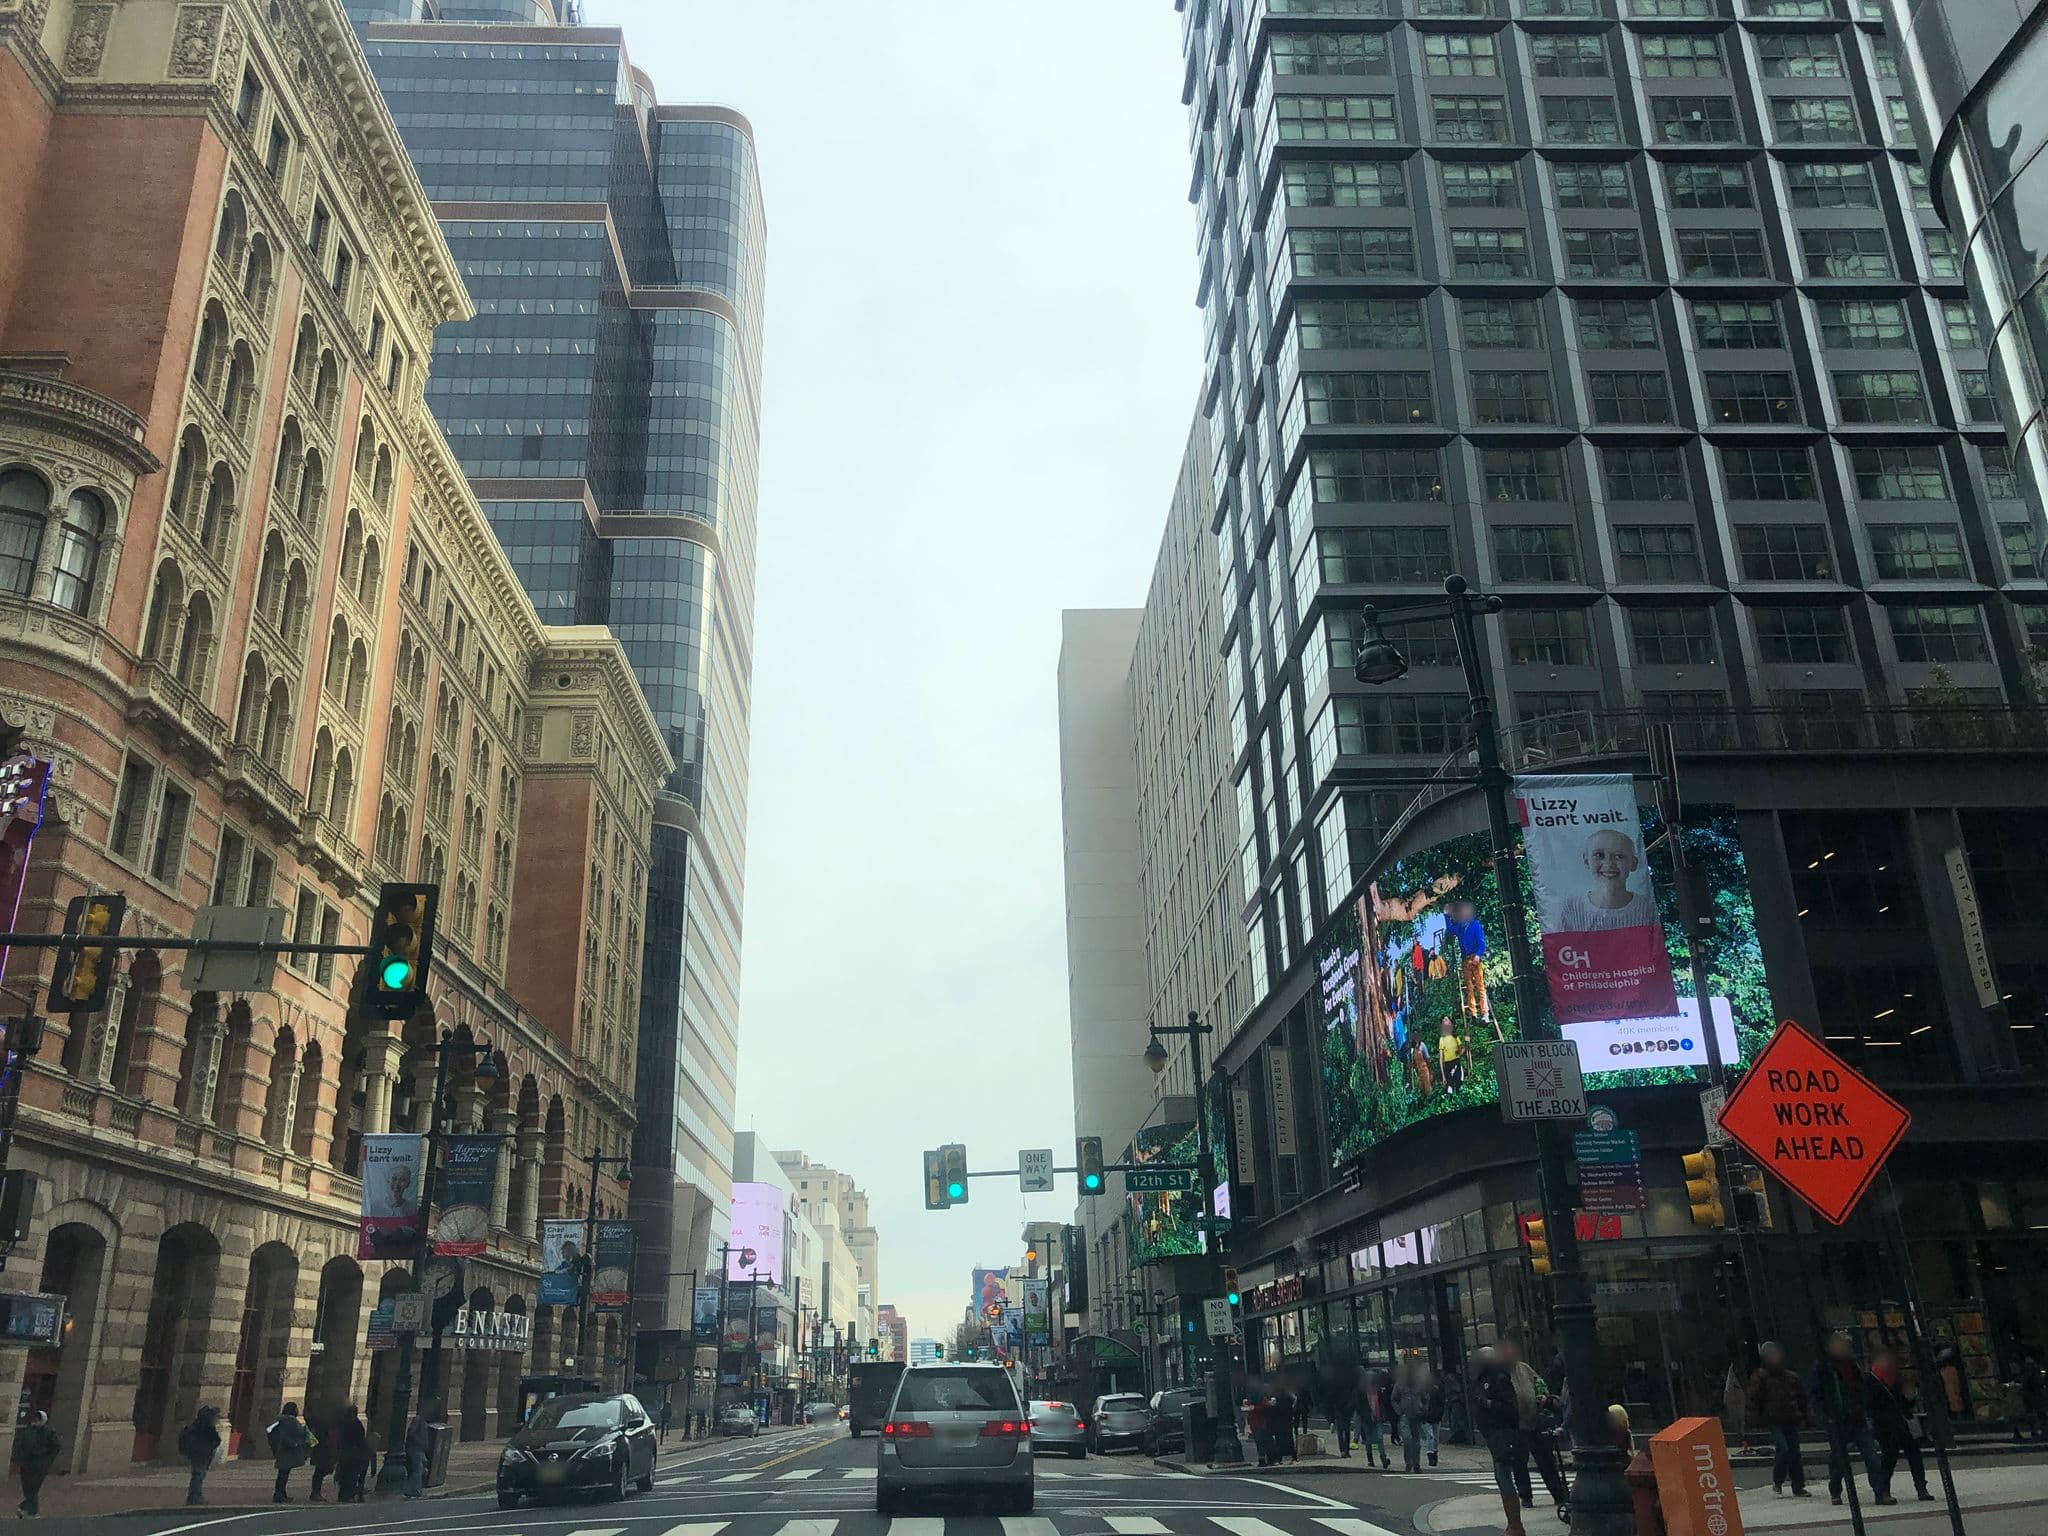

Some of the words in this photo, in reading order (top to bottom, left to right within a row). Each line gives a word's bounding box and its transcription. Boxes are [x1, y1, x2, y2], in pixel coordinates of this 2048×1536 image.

[1530, 797, 1577, 812] Lizzy
[1535, 813, 1579, 827] can't
[1583, 809, 1628, 824] wait.
[1955, 862, 1972, 902] CITY
[1968, 911, 1991, 990] FITNESS
[1562, 971, 1611, 982] Children's
[1613, 965, 1656, 978] Hospital
[1563, 982, 1575, 991] of
[1577, 978, 1640, 991] Philadelphia
[1617, 1027, 1637, 1035] 40K
[1638, 1024, 1680, 1034] members
[1506, 1044, 1536, 1059] DONT
[1537, 1043, 1575, 1058] BLOCK
[1273, 1059, 1286, 1111] FITNESS
[1767, 1070, 1840, 1093] ROAD
[1516, 1101, 1545, 1116] THE
[1551, 1099, 1582, 1115] BOX
[1773, 1103, 1850, 1126] WORK
[1235, 1097, 1245, 1144] FITNESS
[1279, 1117, 1288, 1144] CITY
[369, 1145, 393, 1155] Lizzy
[1774, 1136, 1865, 1160] AHEAD
[368, 1154, 390, 1163] can't
[1025, 1153, 1047, 1163] ONE
[1239, 1148, 1248, 1174] CITY
[1025, 1164, 1048, 1174] WAY
[1132, 1175, 1163, 1188] 12th
[1169, 1174, 1184, 1187] St
[1210, 1301, 1224, 1310] NO
[1210, 1310, 1227, 1318] TURN
[1214, 1318, 1225, 1326] ON
[1692, 1444, 1728, 1536] metro
